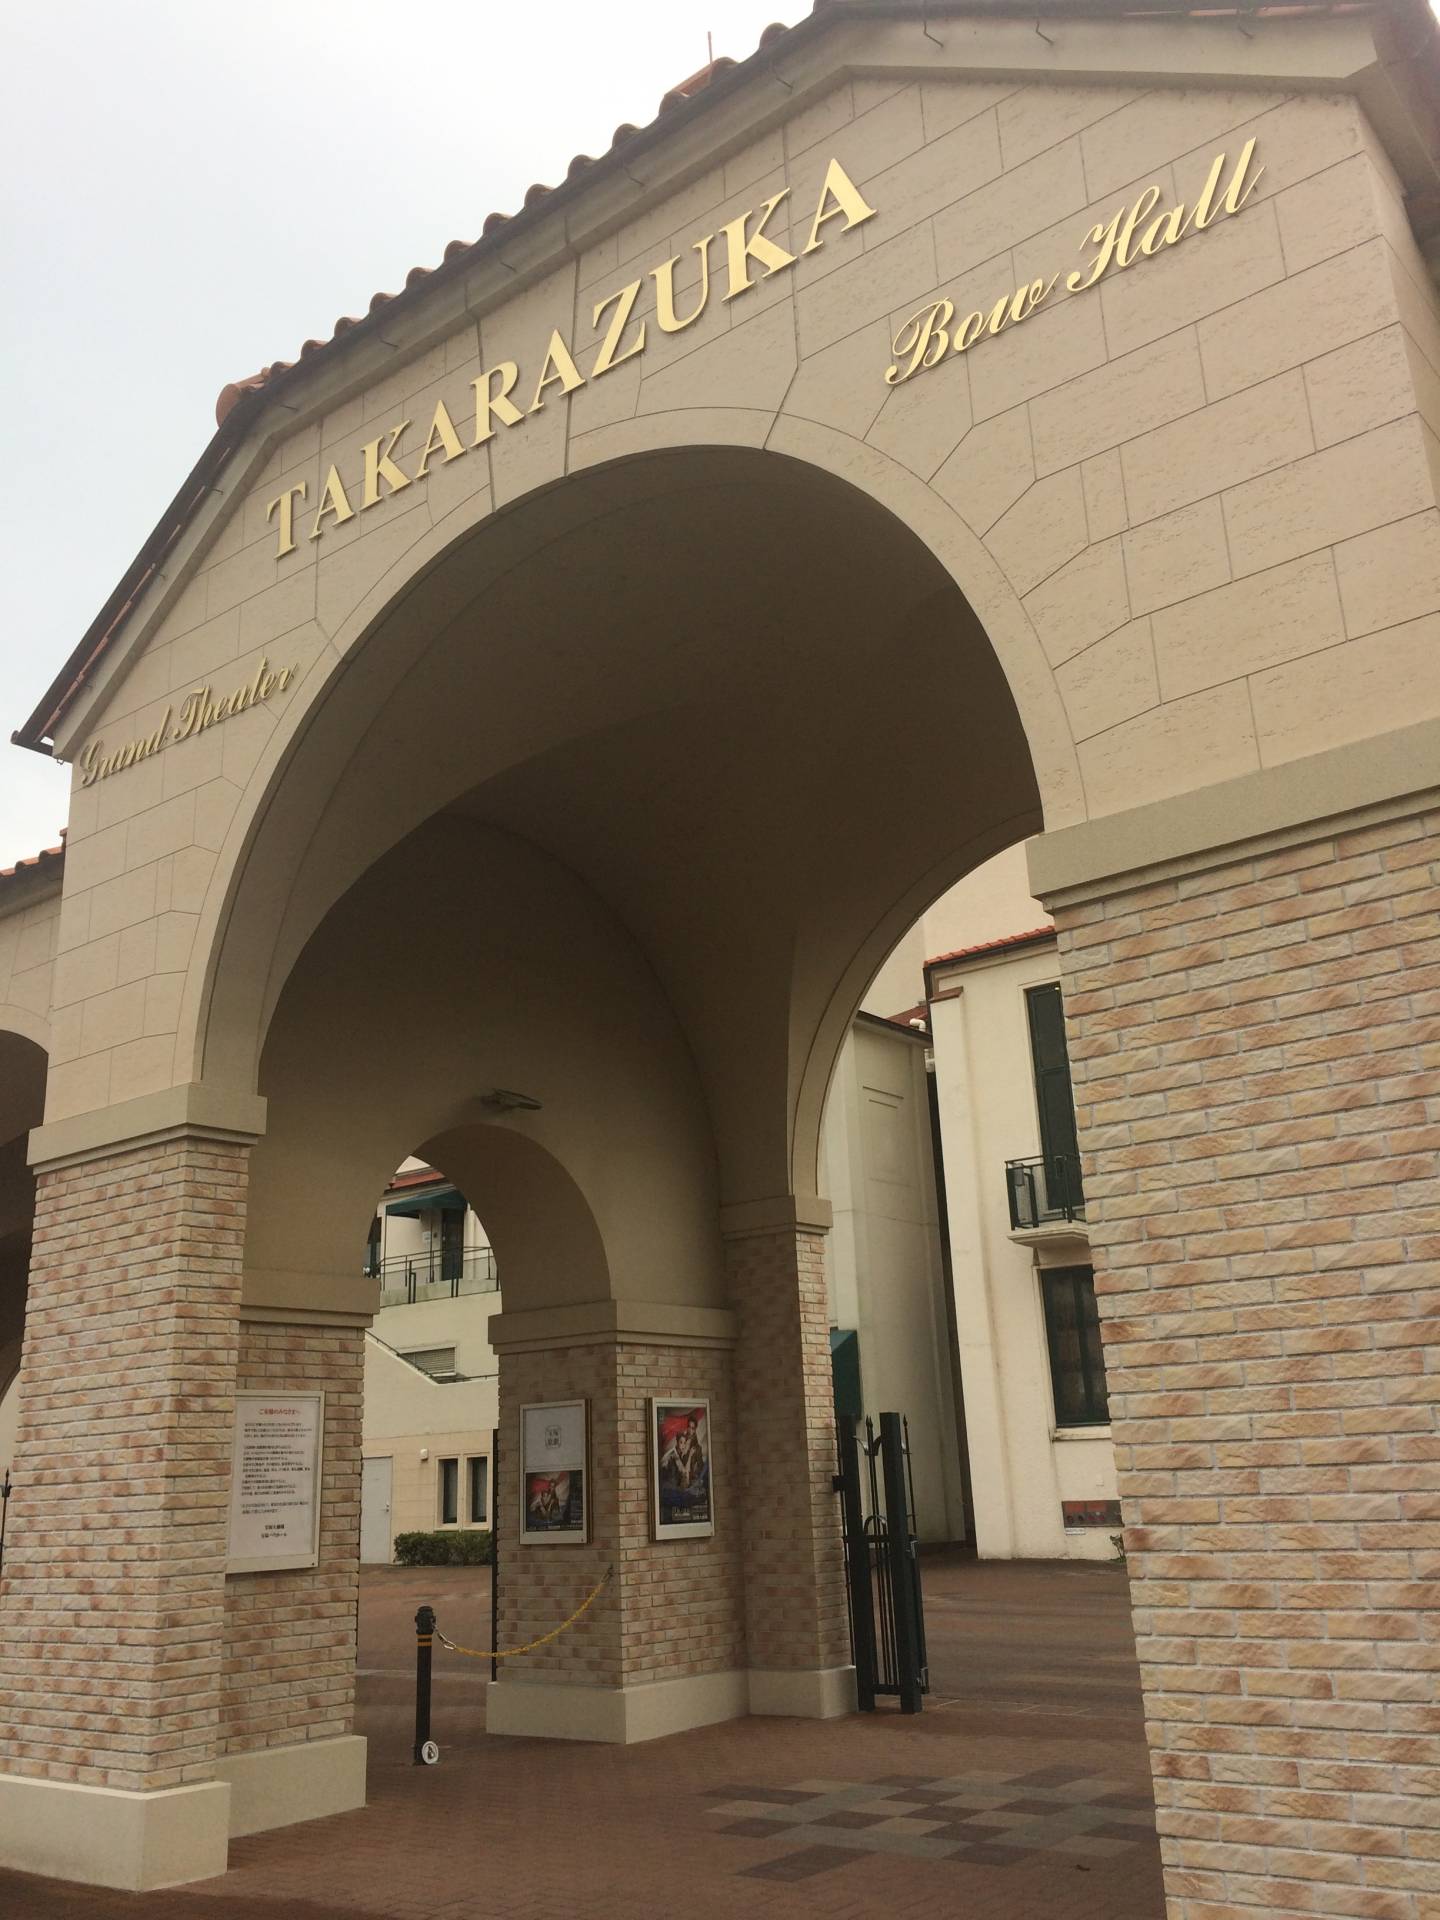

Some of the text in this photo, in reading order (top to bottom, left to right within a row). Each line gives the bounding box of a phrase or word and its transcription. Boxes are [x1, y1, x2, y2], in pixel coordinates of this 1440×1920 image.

[266, 157, 877, 560] TAKARAZUKA
[885, 136, 1266, 385] Bow Hall
[79, 656, 299, 786] Grand Theater
